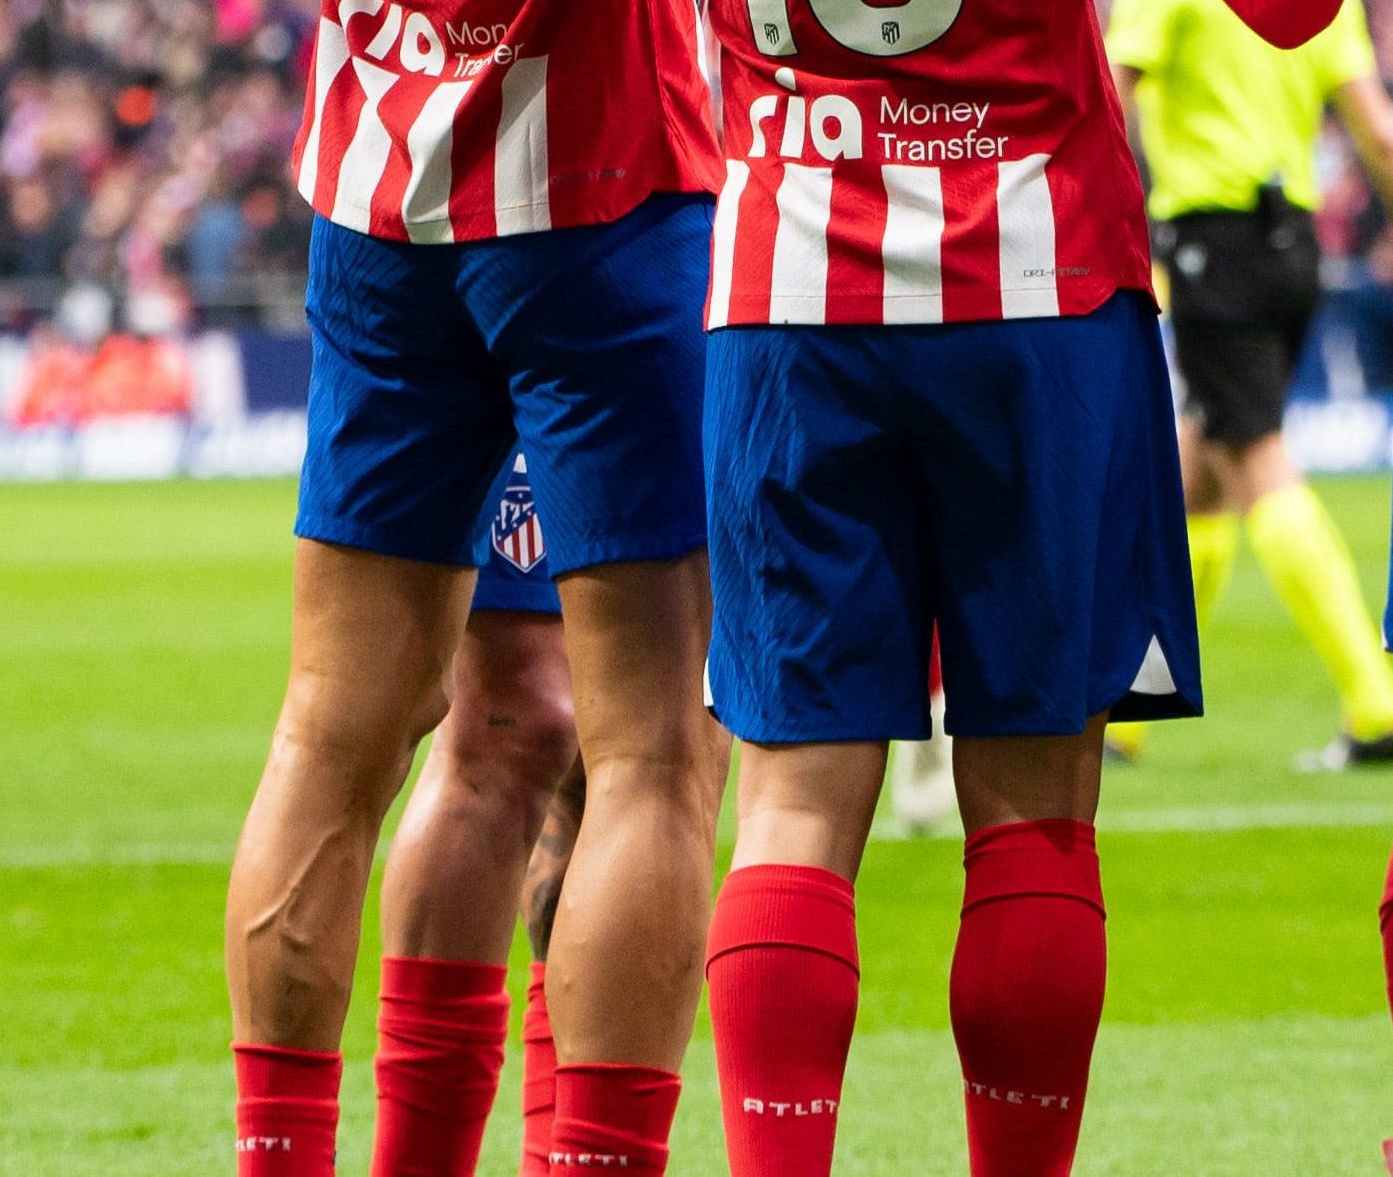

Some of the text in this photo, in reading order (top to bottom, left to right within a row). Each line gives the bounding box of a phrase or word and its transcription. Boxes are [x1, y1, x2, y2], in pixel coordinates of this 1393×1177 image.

[446, 21, 508, 46] Mon
[452, 42, 525, 78] Traer
[748, 66, 863, 161] ria
[879, 95, 990, 125] Money
[877, 130, 1009, 162] Transfer
[743, 1097, 838, 1117] ATLET
[235, 1135, 292, 1152] LETI
